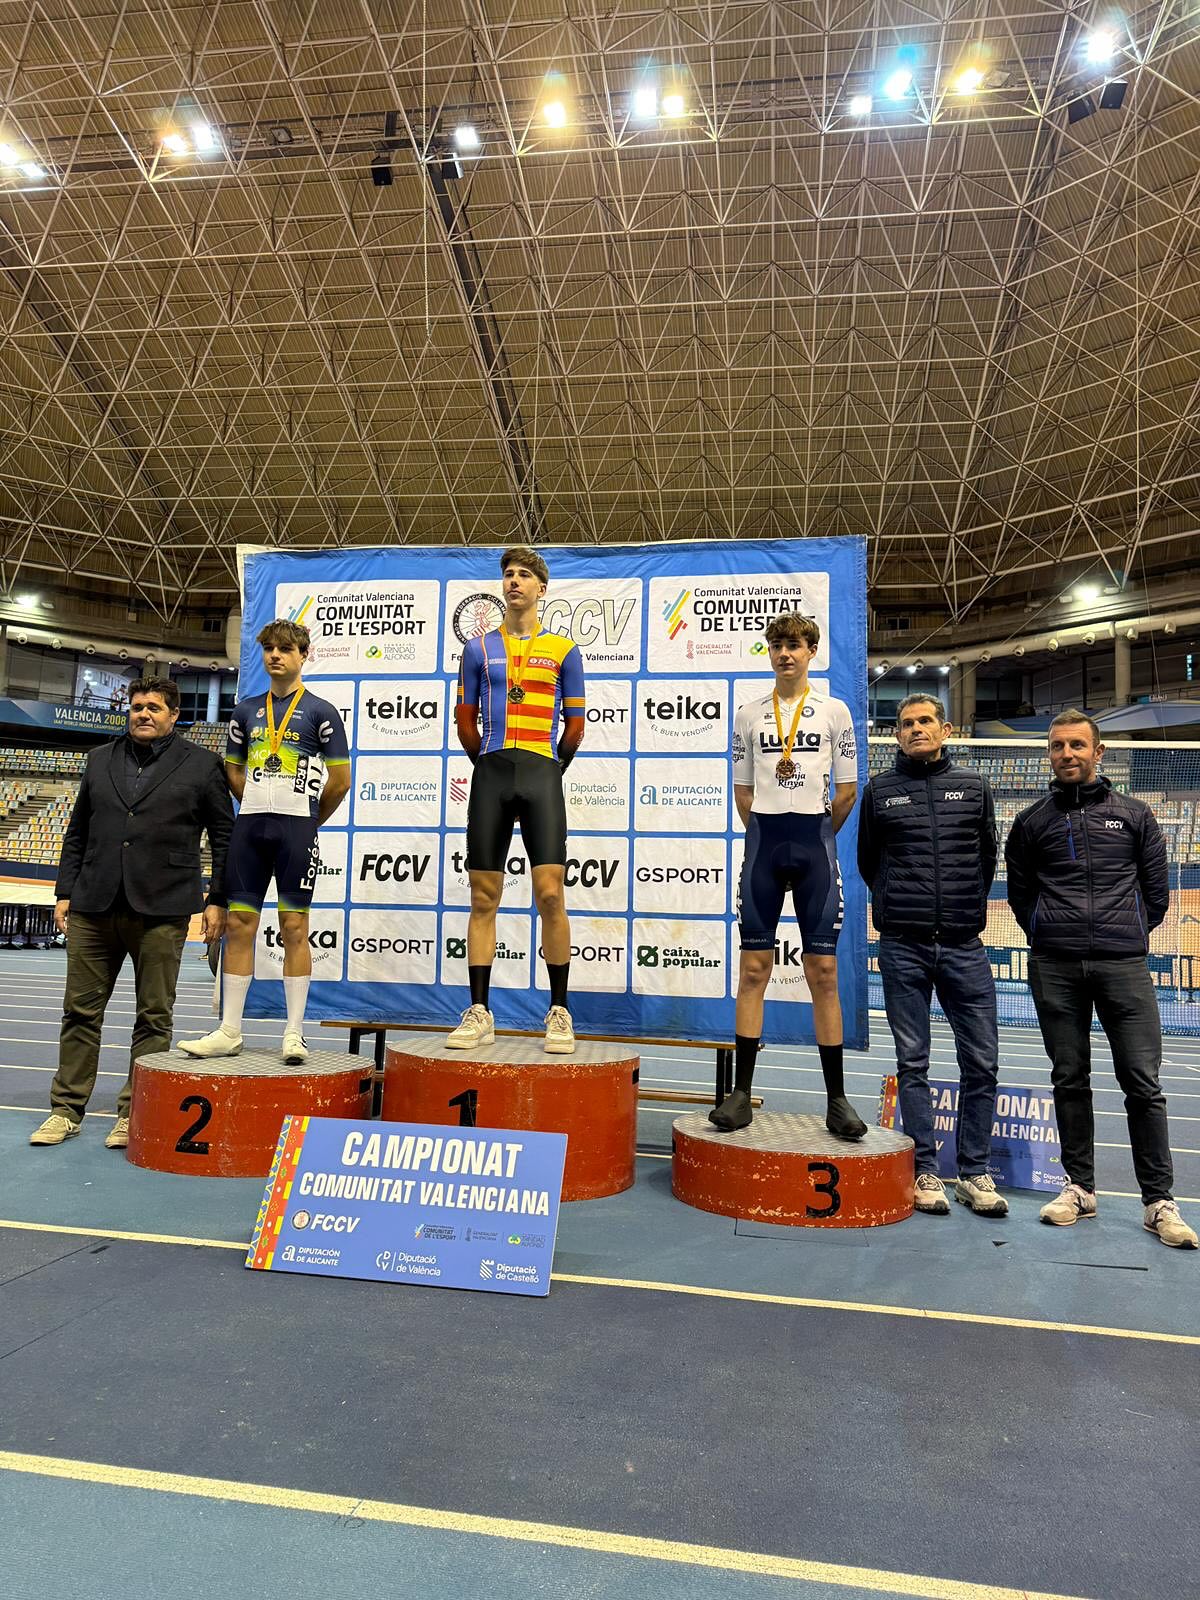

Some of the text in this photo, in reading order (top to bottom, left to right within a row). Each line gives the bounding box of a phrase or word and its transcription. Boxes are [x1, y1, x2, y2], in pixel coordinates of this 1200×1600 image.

[317, 592, 415, 604] Comunitat Valenciana
[694, 586, 801, 597] Comunitat Valenciana
[316, 604, 415, 621] COMUNITAT
[693, 598, 801, 616] COMUNITAT
[322, 620, 426, 637] DE L'ESPORT
[537, 599, 636, 646] CCV
[701, 617, 724, 632] DE
[538, 658, 557, 668] FCCV
[586, 653, 635, 662] Valenciana
[366, 695, 438, 720] teika
[644, 695, 721, 720] teika
[55, 707, 127, 726] VALENCIA 2008
[371, 722, 431, 736] EL BUEN VENDING
[650, 723, 714, 737] EL BUEN VENDING
[296, 768, 306, 792] FCCV
[381, 781, 437, 791] DIPUTACIÓN
[570, 782, 617, 794] Diputació
[662, 784, 722, 795] DIPUTACIÓN
[381, 793, 437, 802] DE ALICANTE
[570, 795, 626, 807] de València
[662, 798, 723, 807] DE ALICANTE
[945, 791, 964, 801] FCCV
[1105, 819, 1125, 830] FCCV
[359, 854, 431, 882] FCCV
[563, 858, 620, 889] CCV
[636, 867, 724, 884] GSPORT
[351, 937, 434, 955] GSPORT
[662, 946, 700, 958] caixa
[662, 957, 721, 969] popular
[448, 1089, 479, 1127] 1
[175, 1095, 213, 1155] 2
[341, 1131, 523, 1178] CAMPIONAT
[299, 1172, 550, 1217] COMUNITAT VALENCIANA
[806, 1162, 842, 1218] 3
[310, 1213, 360, 1233] FCCV
[423, 1227, 455, 1236] COMUNITAT
[298, 1247, 341, 1258] DIPUTACIÓN
[398, 1252, 437, 1264] Diputació
[307, 1257, 339, 1267] ALICANTE
[497, 1262, 537, 1275] Diputació
[396, 1264, 442, 1277] de València
[495, 1272, 540, 1284] de Castelló
